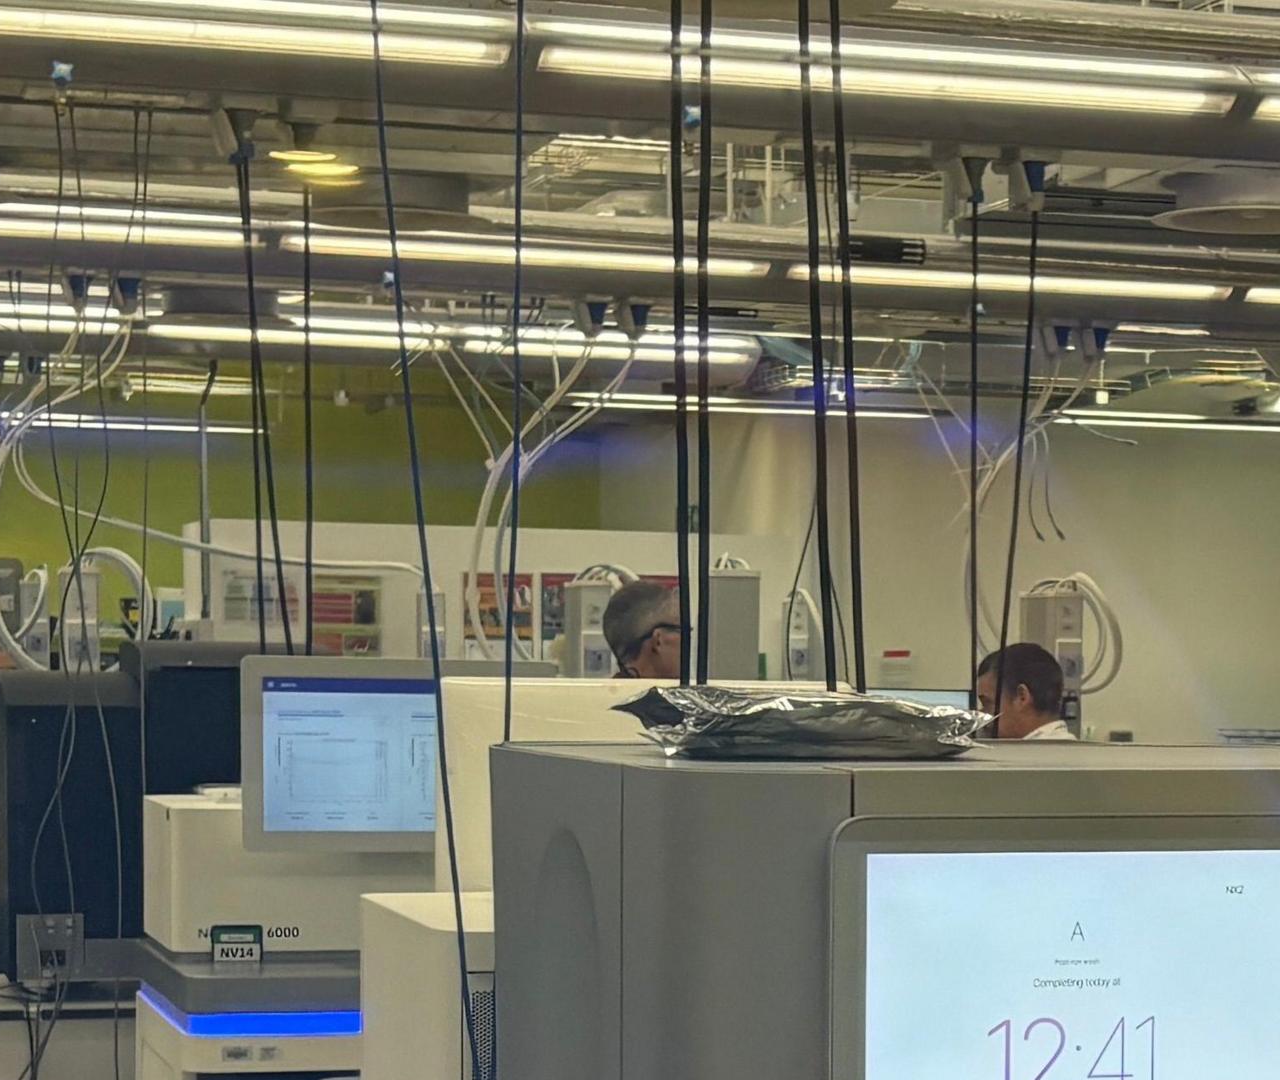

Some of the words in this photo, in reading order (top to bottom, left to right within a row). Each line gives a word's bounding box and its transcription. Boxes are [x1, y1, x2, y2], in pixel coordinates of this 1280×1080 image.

[267, 926, 300, 938] 6000
[1070, 921, 1085, 941] A
[220, 947, 254, 958] NV14
[1032, 977, 1083, 989] Completing
[1085, 977, 1110, 988] today
